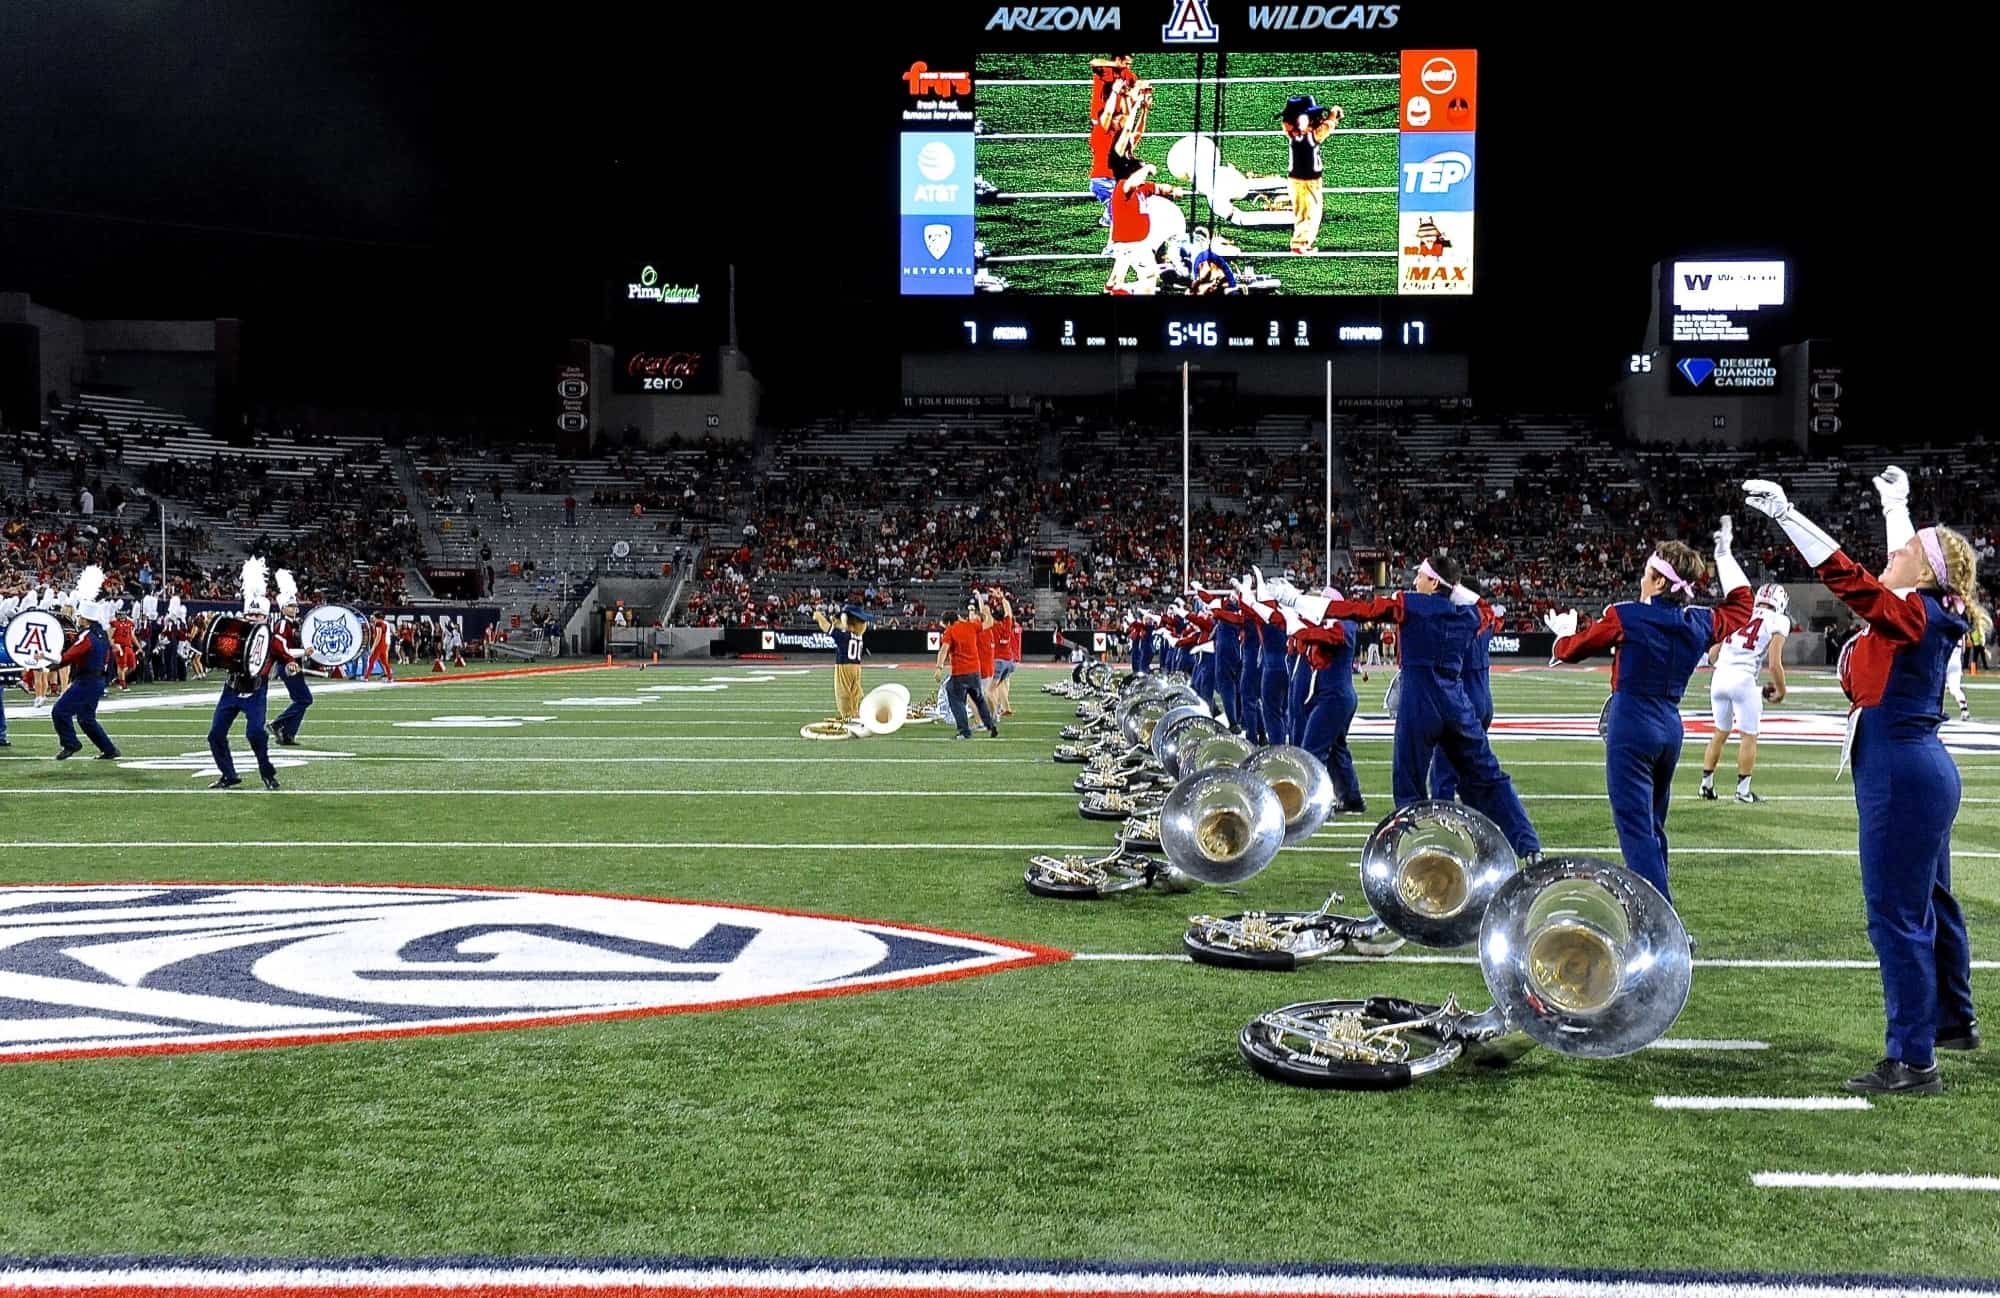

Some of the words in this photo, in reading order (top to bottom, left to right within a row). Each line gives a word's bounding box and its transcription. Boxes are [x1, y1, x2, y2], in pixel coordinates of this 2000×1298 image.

[985, 6, 1121, 31] ARIZONA
[1162, 0, 1219, 43] A
[1248, 5, 1401, 30] WILDCATS
[1403, 159, 1467, 193] TEP
[914, 184, 960, 203] AT&T
[903, 266, 973, 276] NETWORKS
[963, 321, 977, 344] 7
[1064, 320, 1074, 336] 3
[1168, 321, 1218, 346] 5:46
[1270, 320, 1279, 336] 3
[1298, 320, 1308, 336] 3
[1402, 321, 1425, 345] 17
[1086, 337, 1106, 346] DOWN
[1630, 355, 1652, 373] 25
[1719, 358, 1771, 368] DESERT
[1713, 368, 1777, 377] DIAMOND
[643, 377, 683, 390] zero
[1714, 377, 1775, 387] CASINOS
[707, 416, 719, 427] 10
[15, 622, 51, 655] A
[250, 634, 265, 666] A
